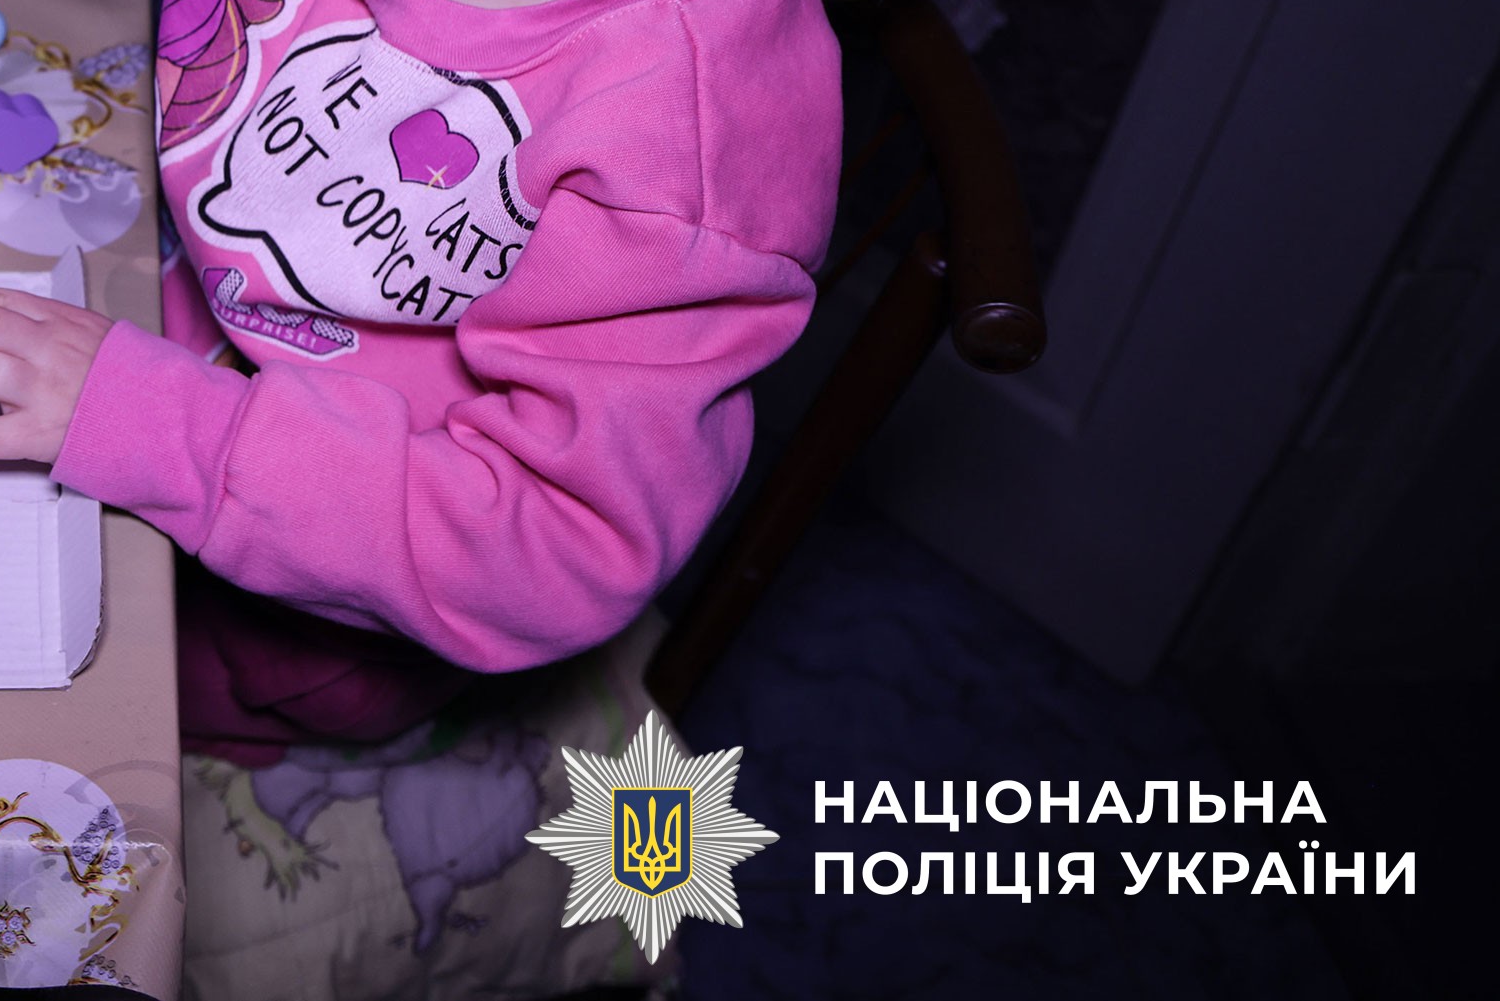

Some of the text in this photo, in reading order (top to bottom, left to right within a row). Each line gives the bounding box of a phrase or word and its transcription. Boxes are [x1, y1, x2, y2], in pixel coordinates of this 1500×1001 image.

[257, 86, 484, 324] NOT COPYCAT
[425, 198, 524, 280] CATS
